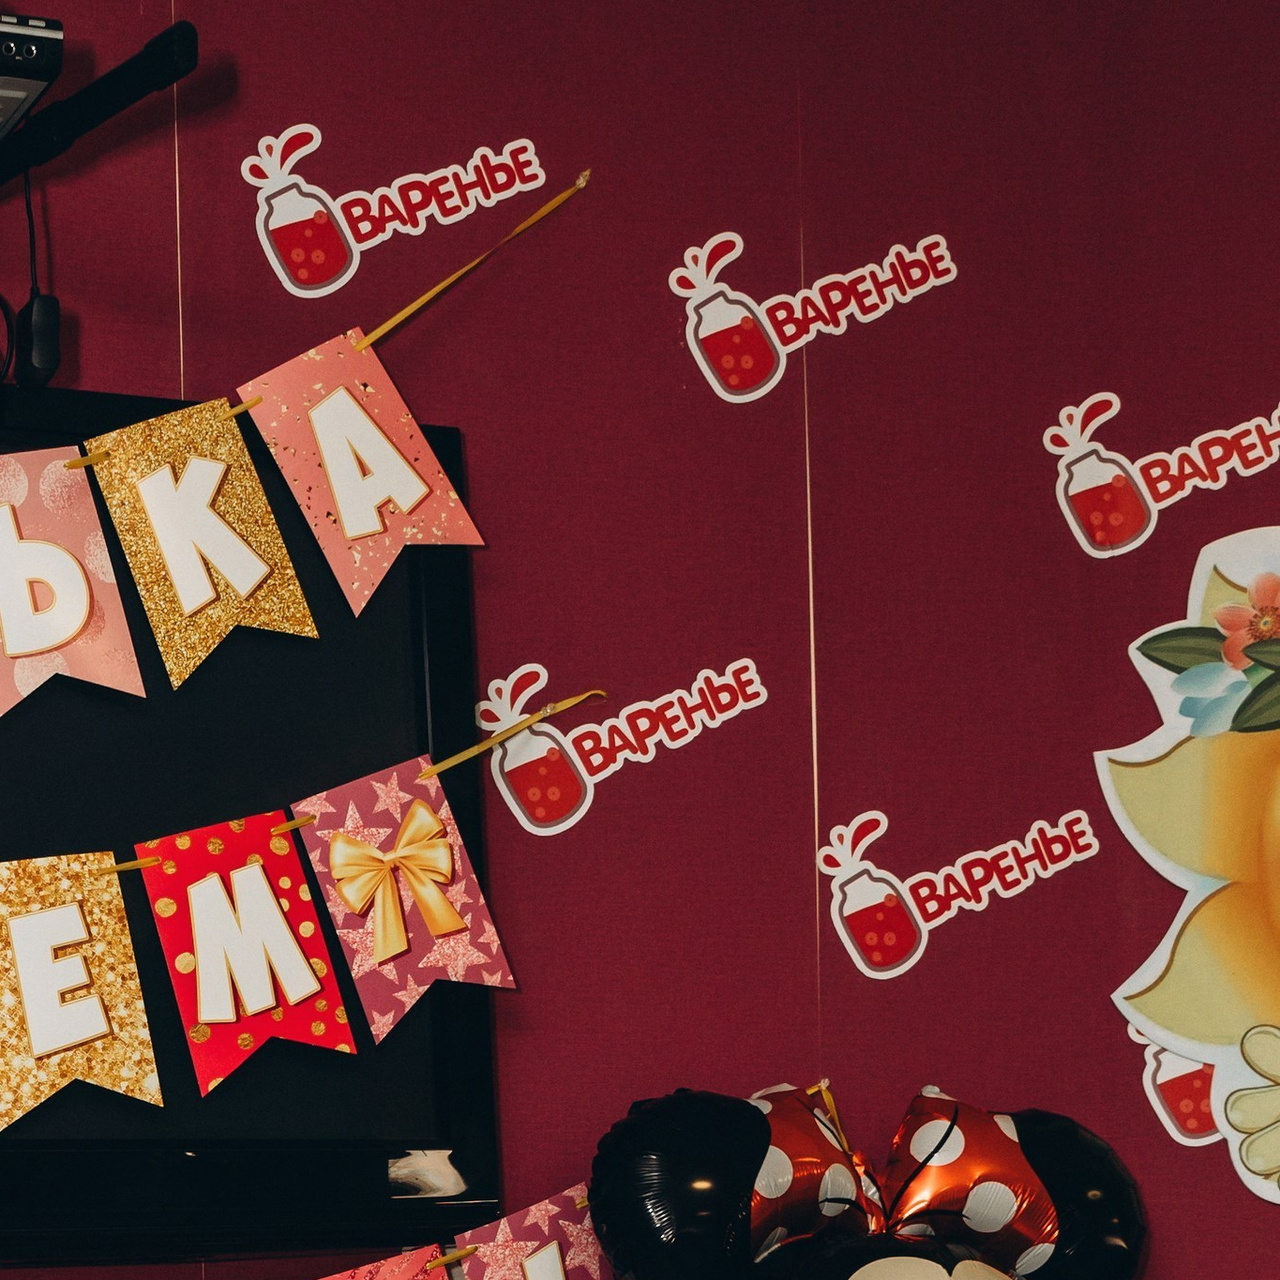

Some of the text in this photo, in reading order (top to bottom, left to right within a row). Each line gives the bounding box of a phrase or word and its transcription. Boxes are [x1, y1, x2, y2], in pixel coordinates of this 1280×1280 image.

[341, 143, 539, 243] ВАРЕНЬЕ
[767, 240, 952, 347] ВАРЕНЬЕ
[572, 663, 759, 777] ВАРЕНЬЕ
[910, 814, 1093, 923] ВАРЕНЬЕ
